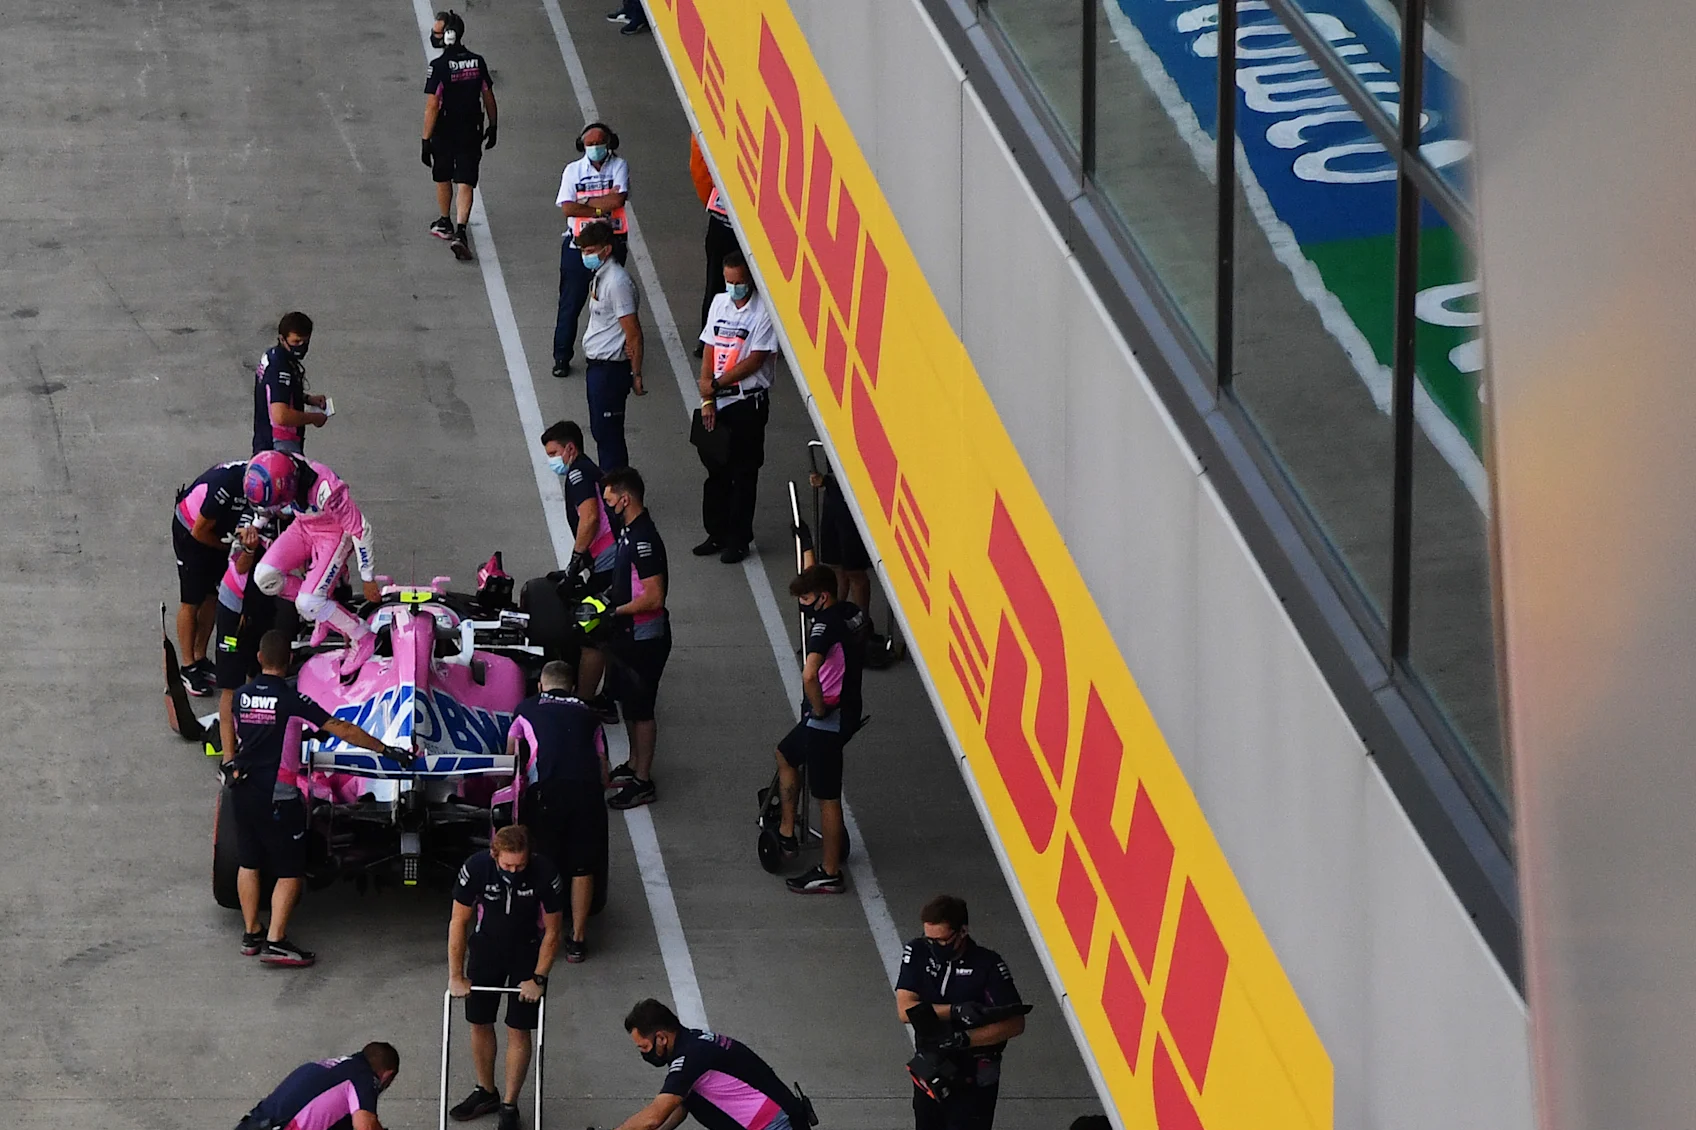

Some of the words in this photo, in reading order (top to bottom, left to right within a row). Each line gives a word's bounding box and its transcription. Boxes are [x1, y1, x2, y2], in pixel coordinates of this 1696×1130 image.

[758, 13, 898, 526] DHL
[251, 696, 278, 709] BWT
[432, 689, 512, 754] BW
